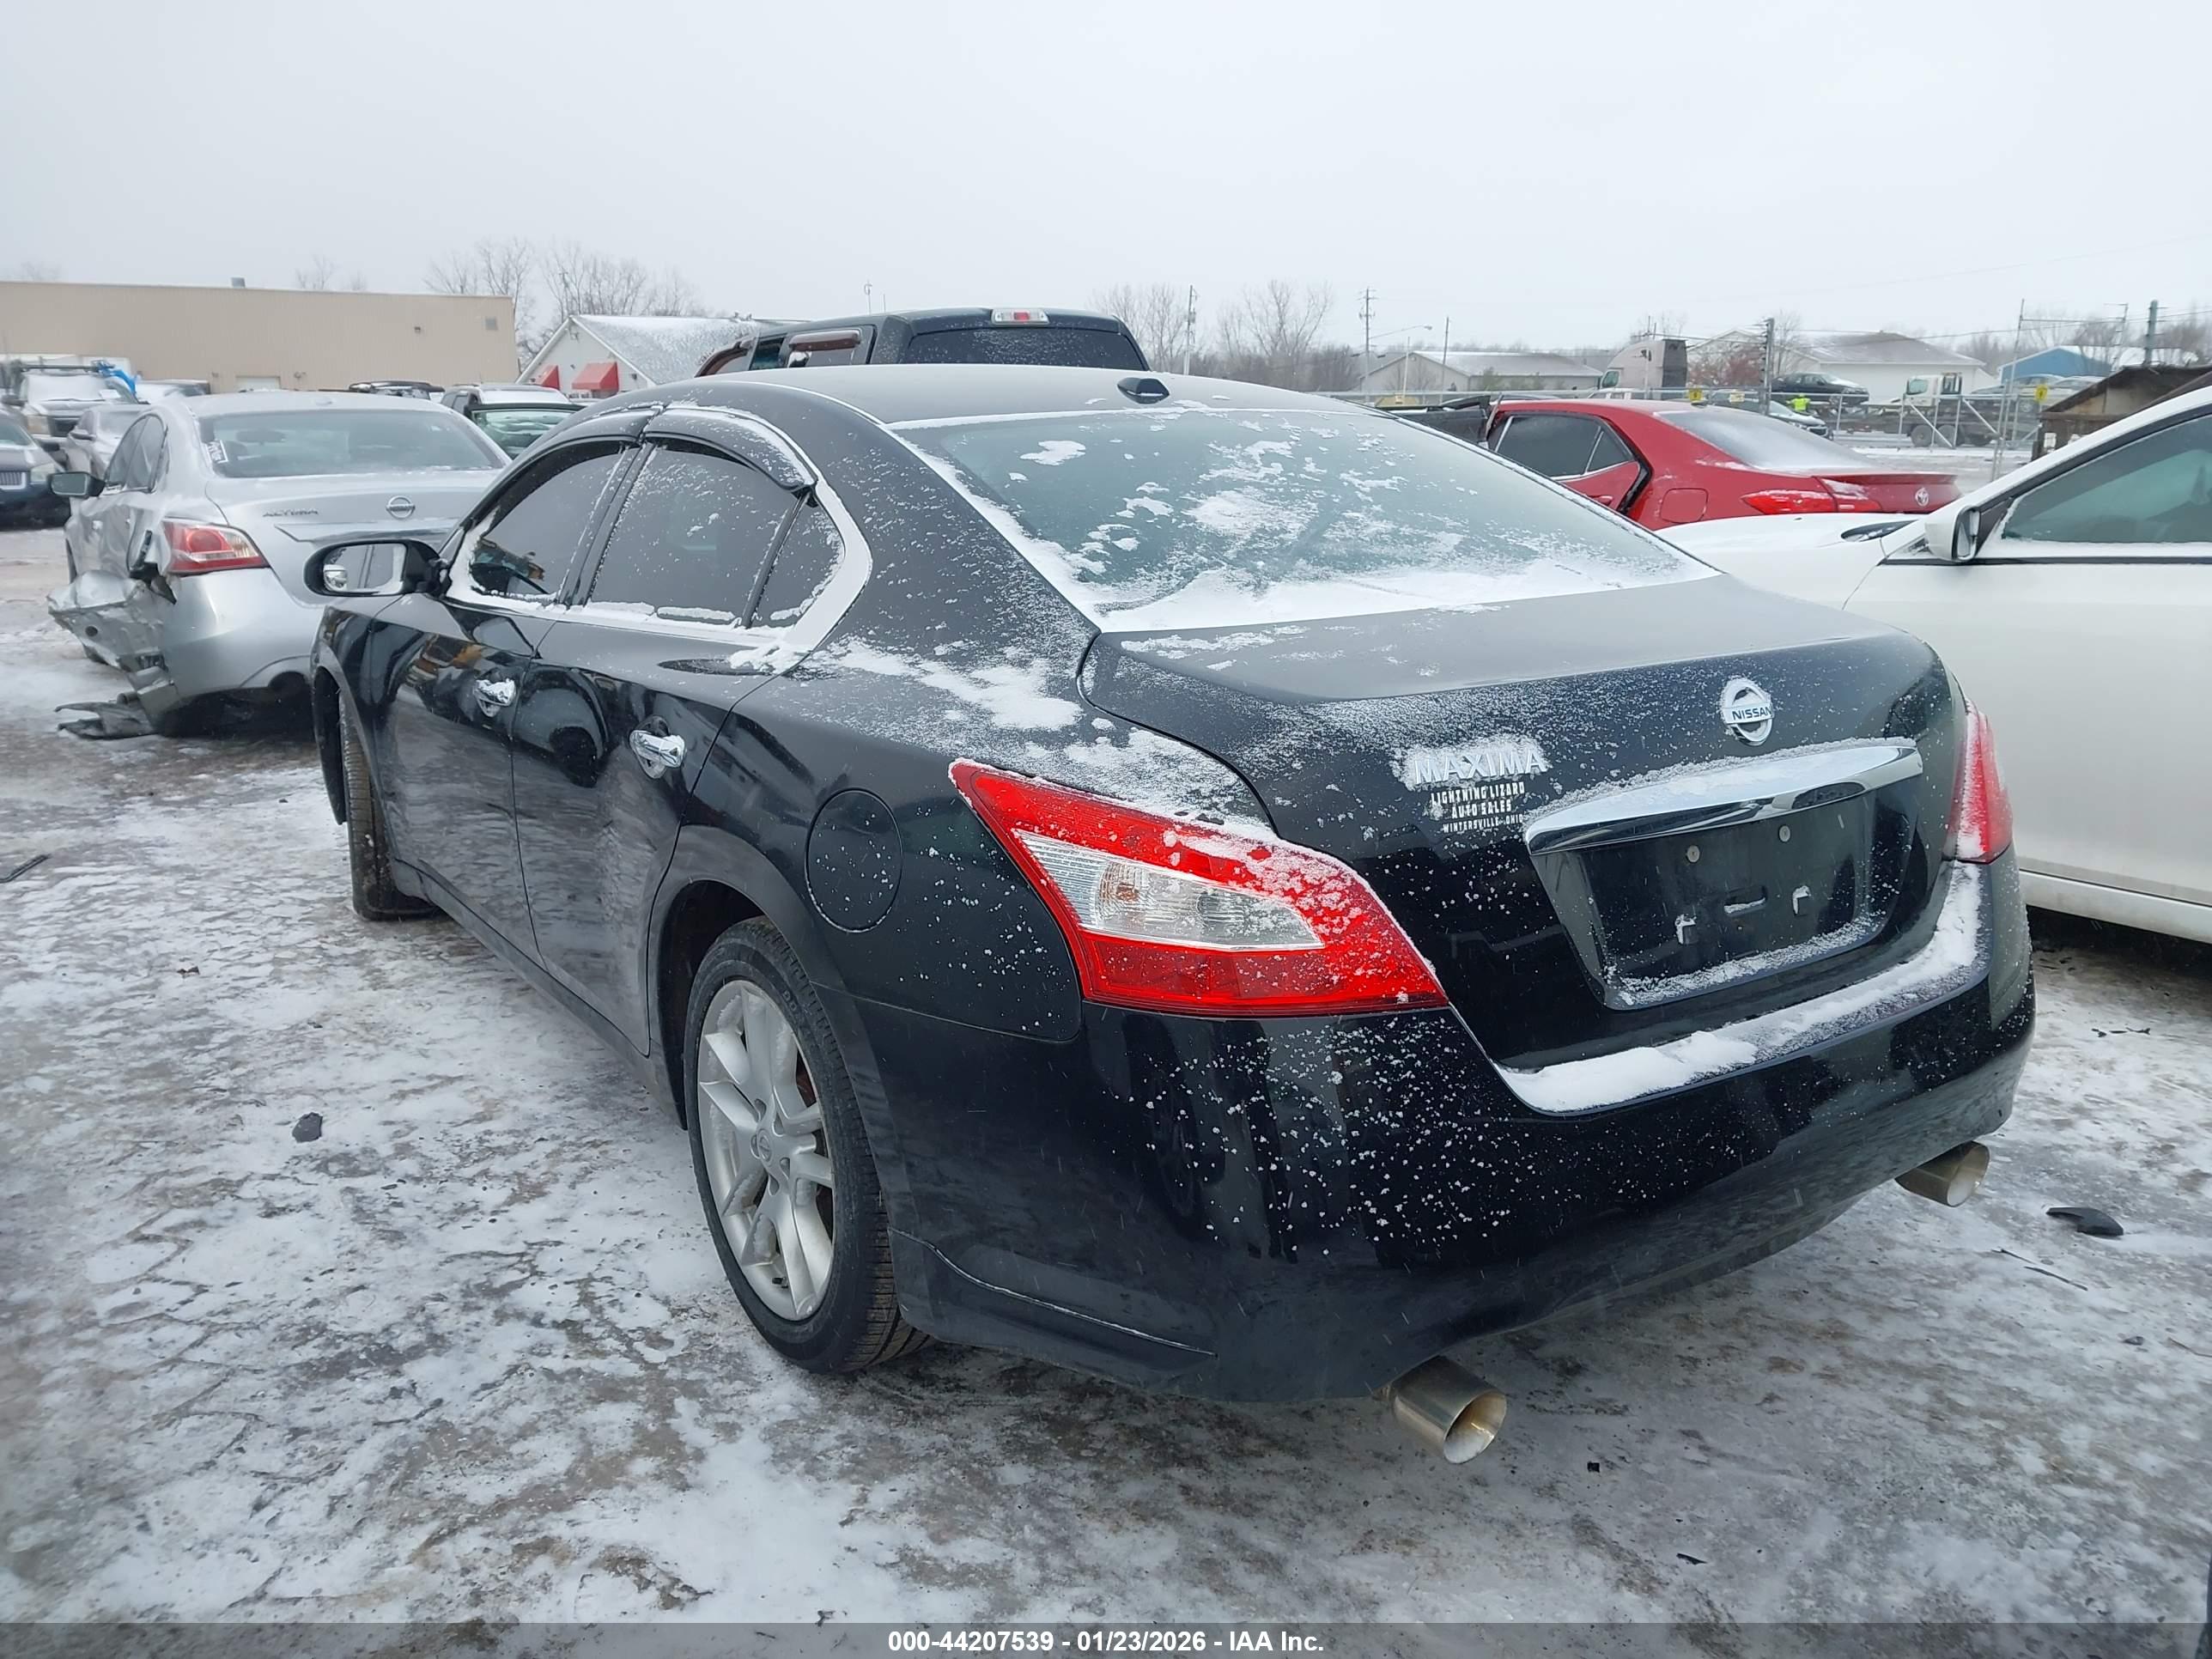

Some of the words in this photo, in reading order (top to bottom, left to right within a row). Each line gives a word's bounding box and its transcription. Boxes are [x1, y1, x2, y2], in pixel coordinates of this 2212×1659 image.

[1731, 705, 1772, 720] NISSAN
[1414, 748, 1548, 785] MAXIMA
[1431, 786, 1486, 805] LIGHTNING
[1489, 781, 1525, 799] LIZARD
[1451, 804, 1478, 818] AUTO
[1480, 799, 1512, 816] SALES
[1505, 814, 1523, 825] OHIO
